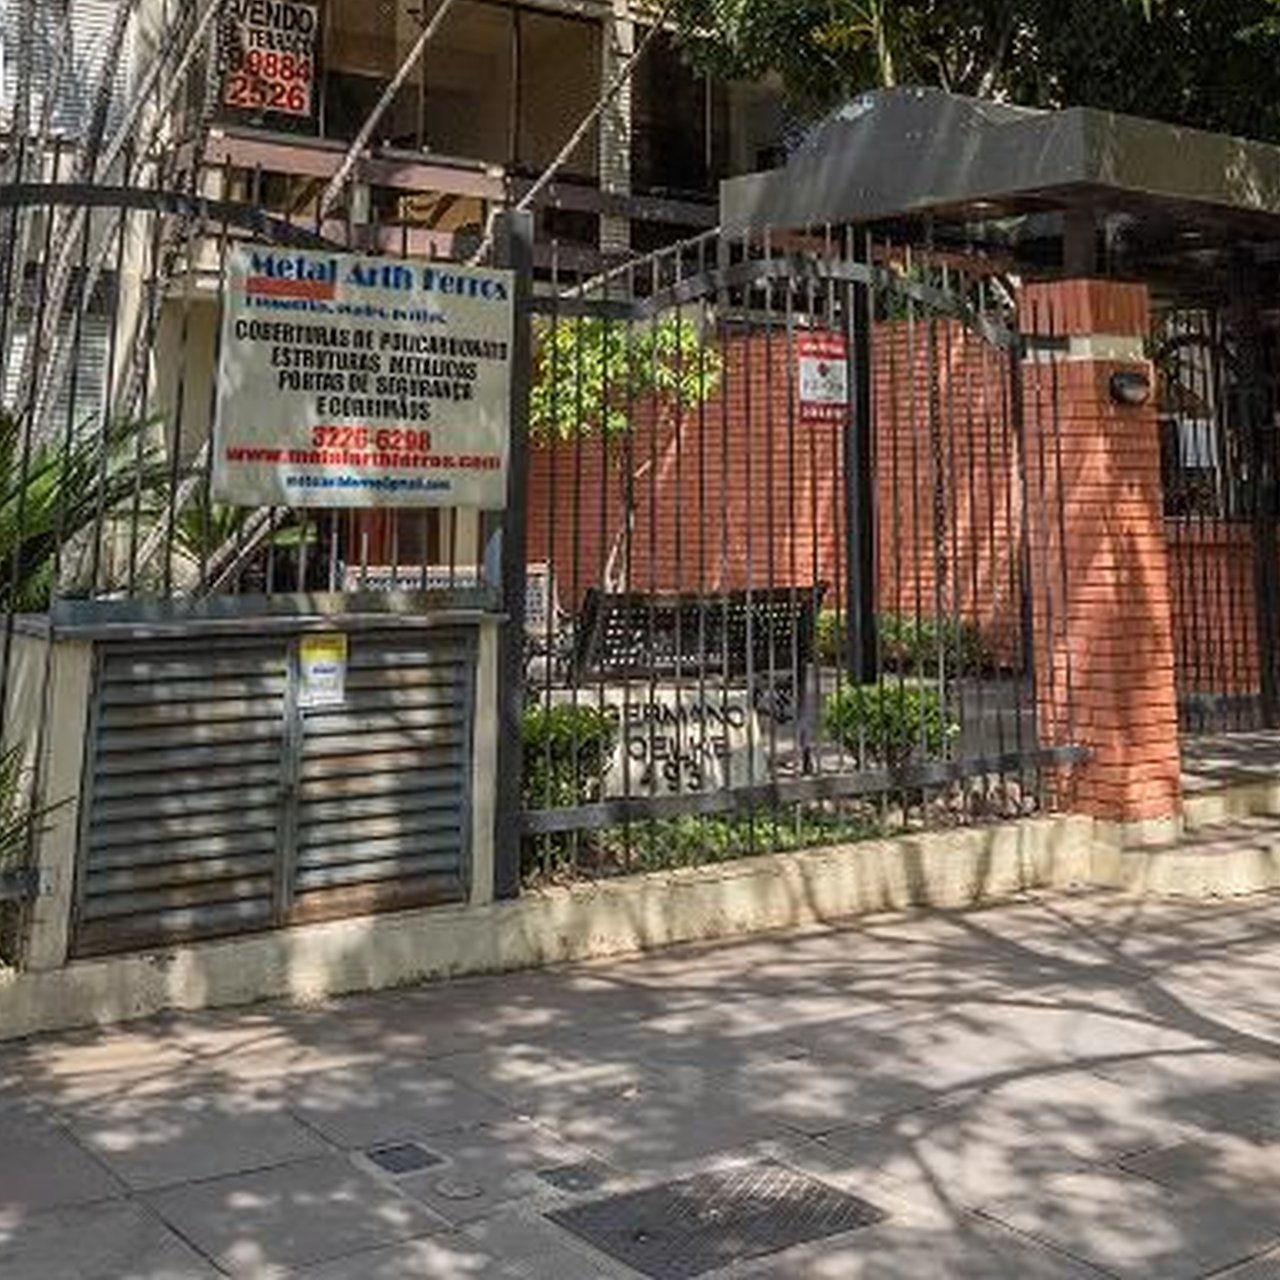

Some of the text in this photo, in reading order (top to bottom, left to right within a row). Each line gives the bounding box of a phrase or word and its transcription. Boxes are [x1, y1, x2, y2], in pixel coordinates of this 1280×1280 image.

[229, 76, 306, 110] 2526
[249, 252, 337, 284] Metal
[422, 268, 507, 300] Ferros
[235, 320, 350, 347] COBERTURAS
[352, 329, 374, 351] DE
[271, 346, 381, 373] ESTRUTURAS
[278, 369, 344, 391] PORTAS
[349, 372, 369, 393] DE
[607, 704, 745, 728] GERMANO
